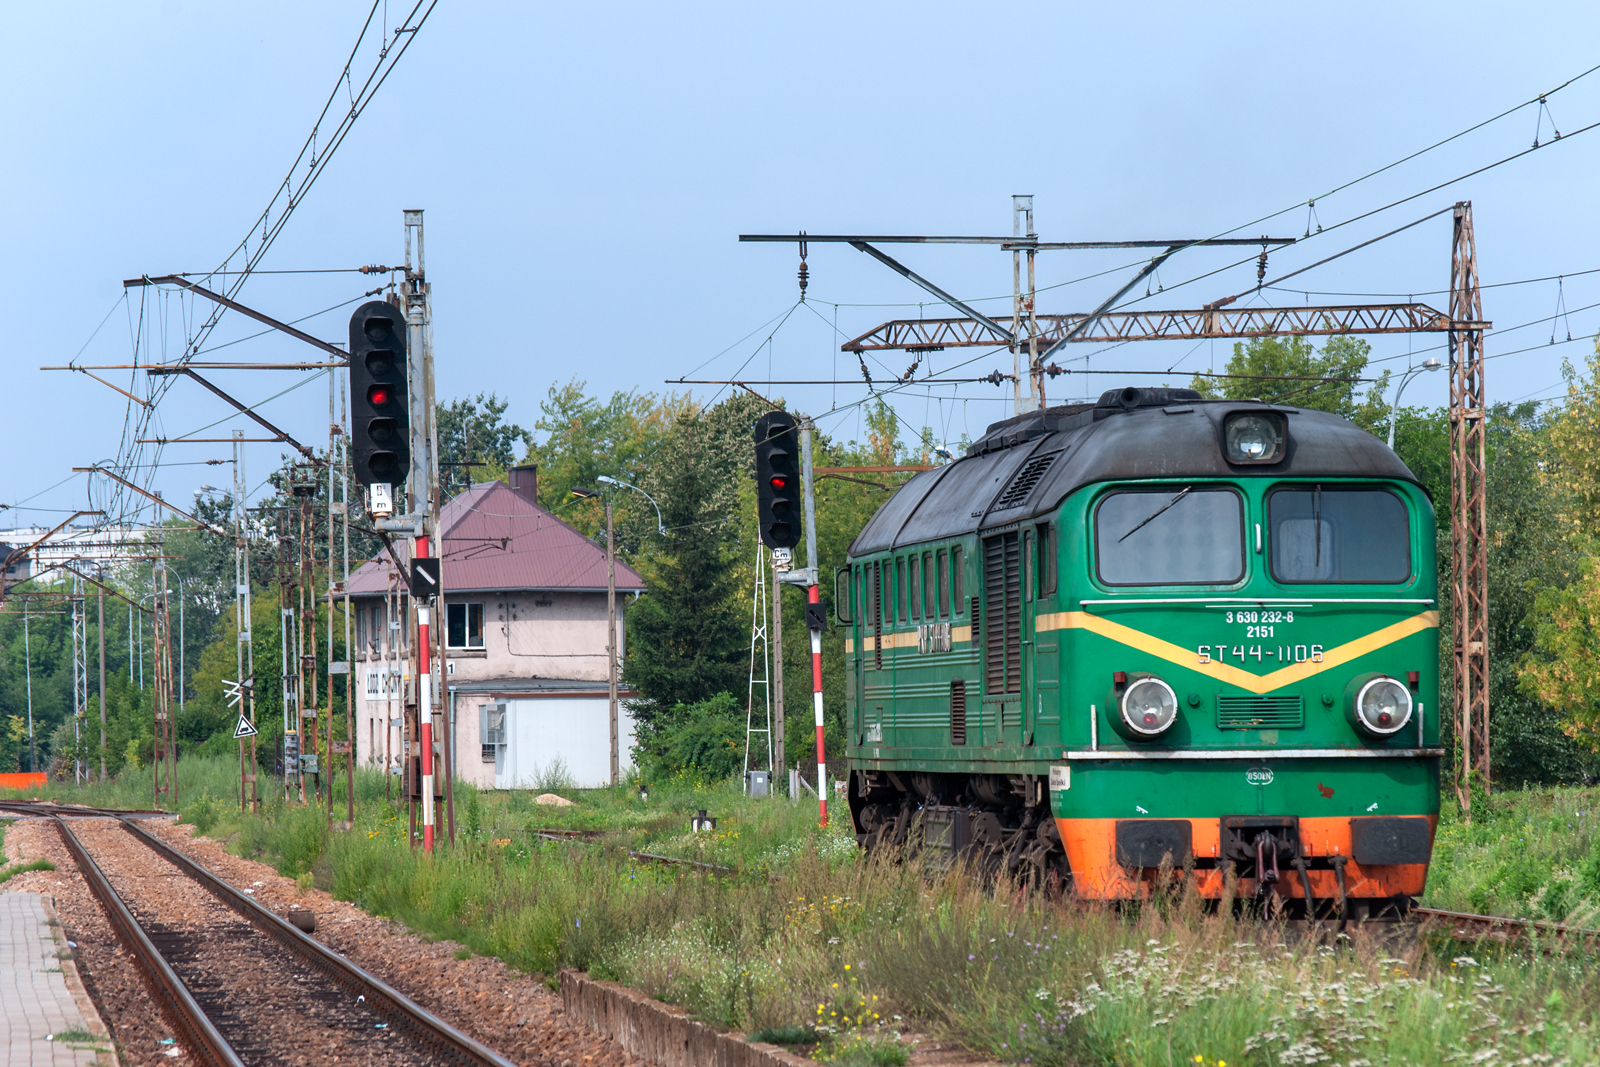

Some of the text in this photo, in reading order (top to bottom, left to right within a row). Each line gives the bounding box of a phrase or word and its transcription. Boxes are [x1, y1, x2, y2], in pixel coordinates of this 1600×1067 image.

[1225, 611, 1294, 623] 3 630 232-8
[1246, 625, 1274, 638] 2151
[1197, 644, 1324, 664] ST44-1106
